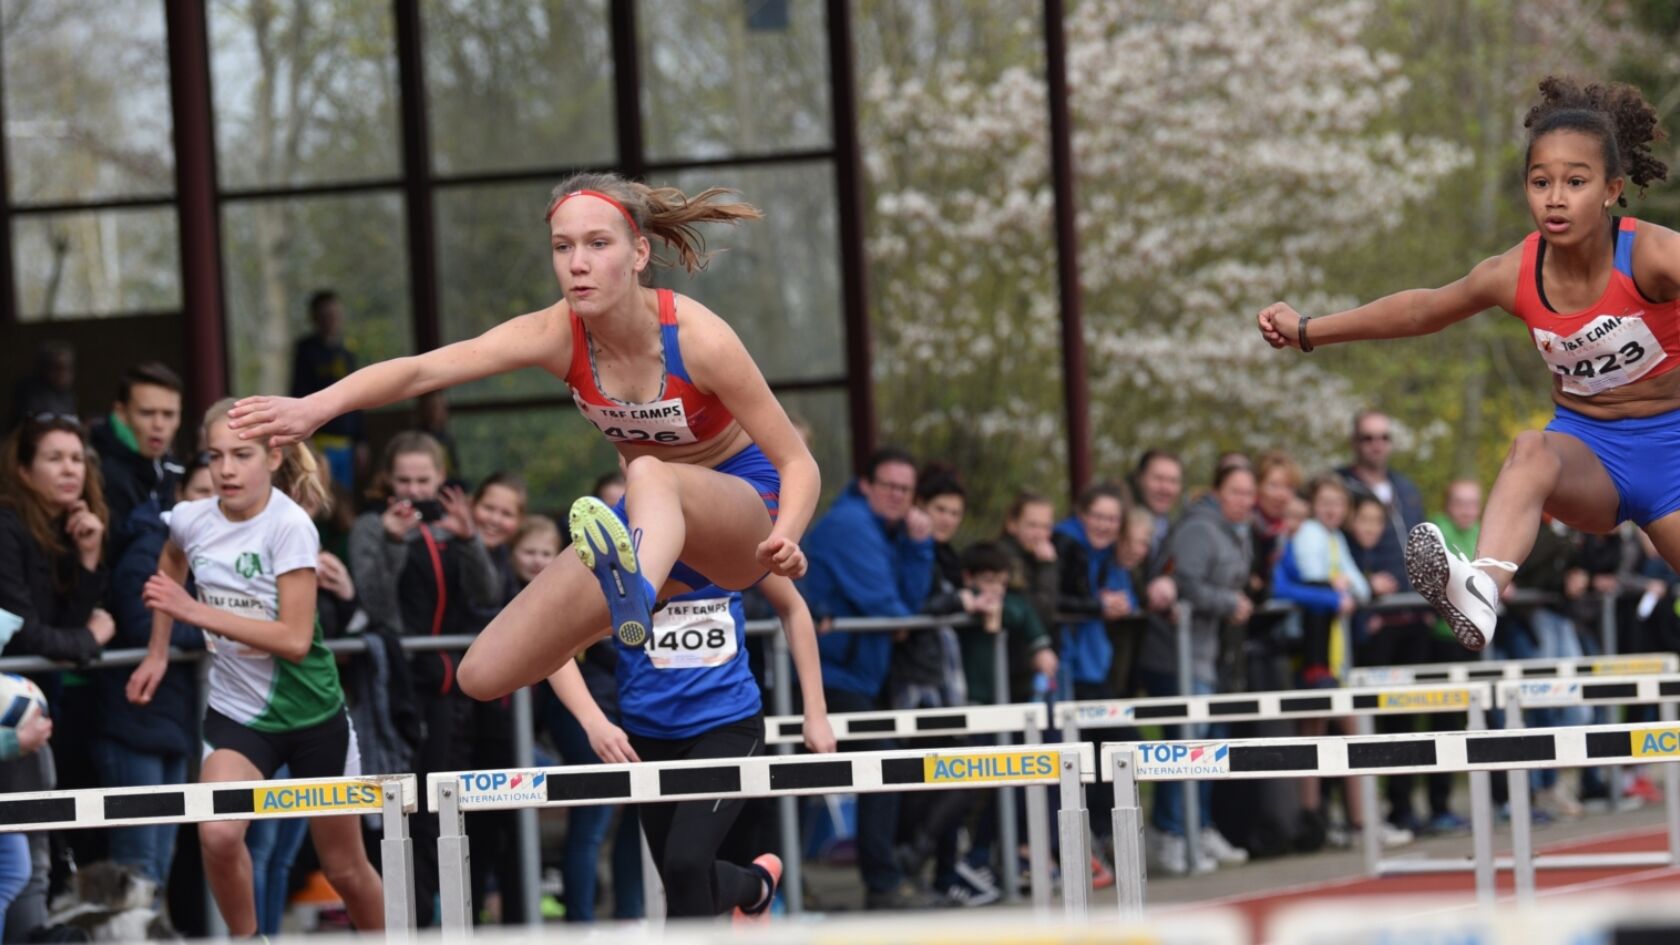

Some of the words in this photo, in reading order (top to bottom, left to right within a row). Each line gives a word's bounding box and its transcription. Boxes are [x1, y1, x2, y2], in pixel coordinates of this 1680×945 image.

[1561, 338, 1585, 353] T&F
[1586, 317, 1623, 343] CAMP
[600, 409, 627, 419] T&F
[630, 405, 682, 420] CAMPS
[667, 606, 689, 616] T&F
[692, 602, 727, 615] CAMPS
[649, 628, 726, 651] 1408
[1641, 731, 1680, 753] AC
[1138, 744, 1188, 763] TOP
[934, 754, 1053, 779] ACHILLES
[1136, 765, 1226, 776] INTERNATIONAL
[460, 772, 507, 792] TOP
[263, 785, 376, 810] ACHILLES
[459, 792, 543, 804] INTERNATIONAL
